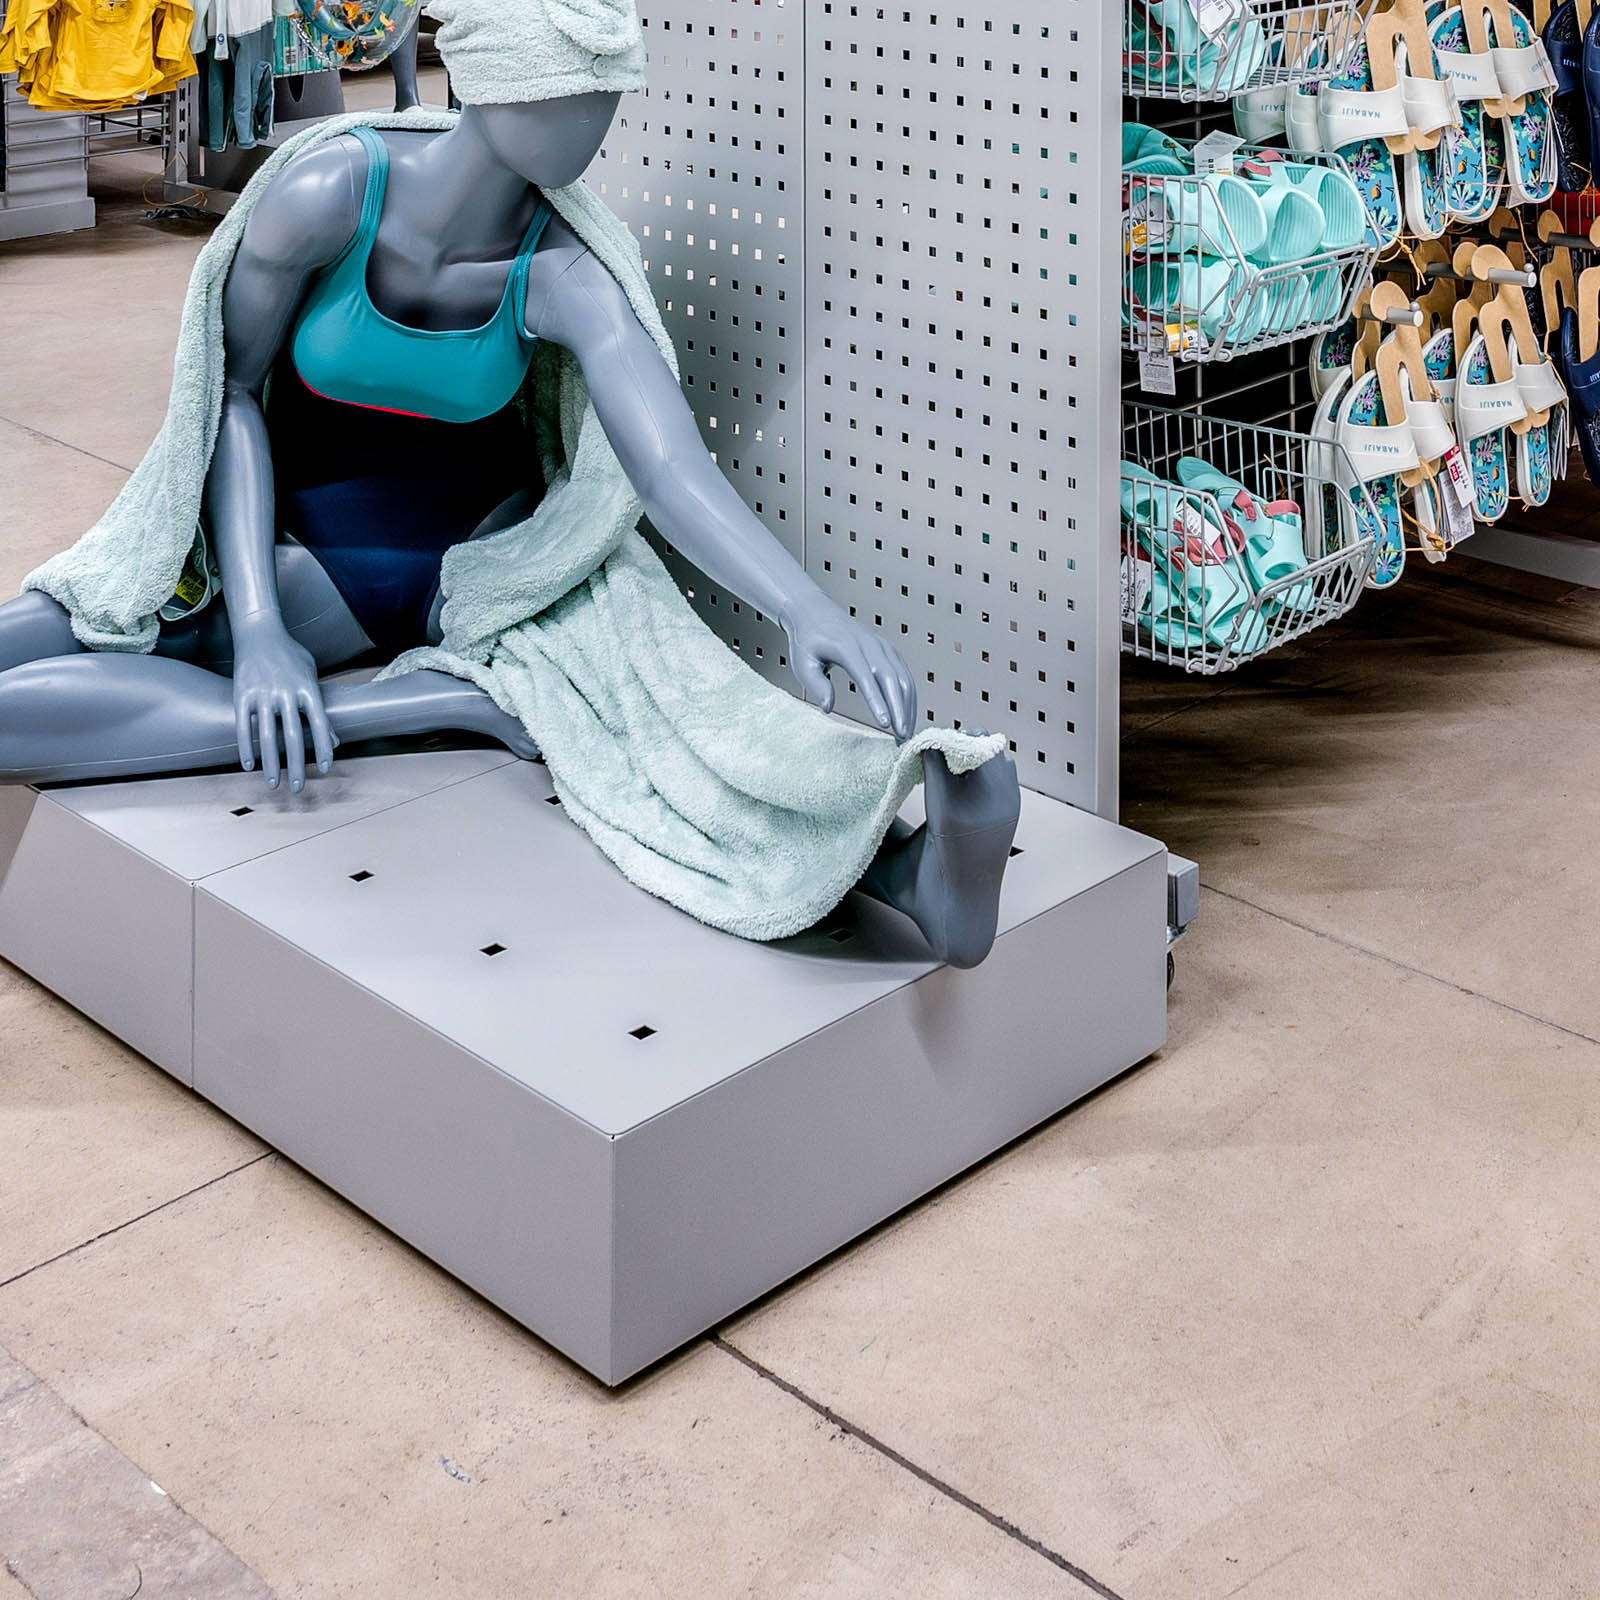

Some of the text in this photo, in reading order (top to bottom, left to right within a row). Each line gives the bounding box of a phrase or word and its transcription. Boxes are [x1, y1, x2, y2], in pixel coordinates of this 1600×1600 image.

[1342, 107, 1381, 119] NABAIJI
[1479, 400, 1513, 409] NABAIJI
[1364, 443, 1400, 454] NABAIJI
